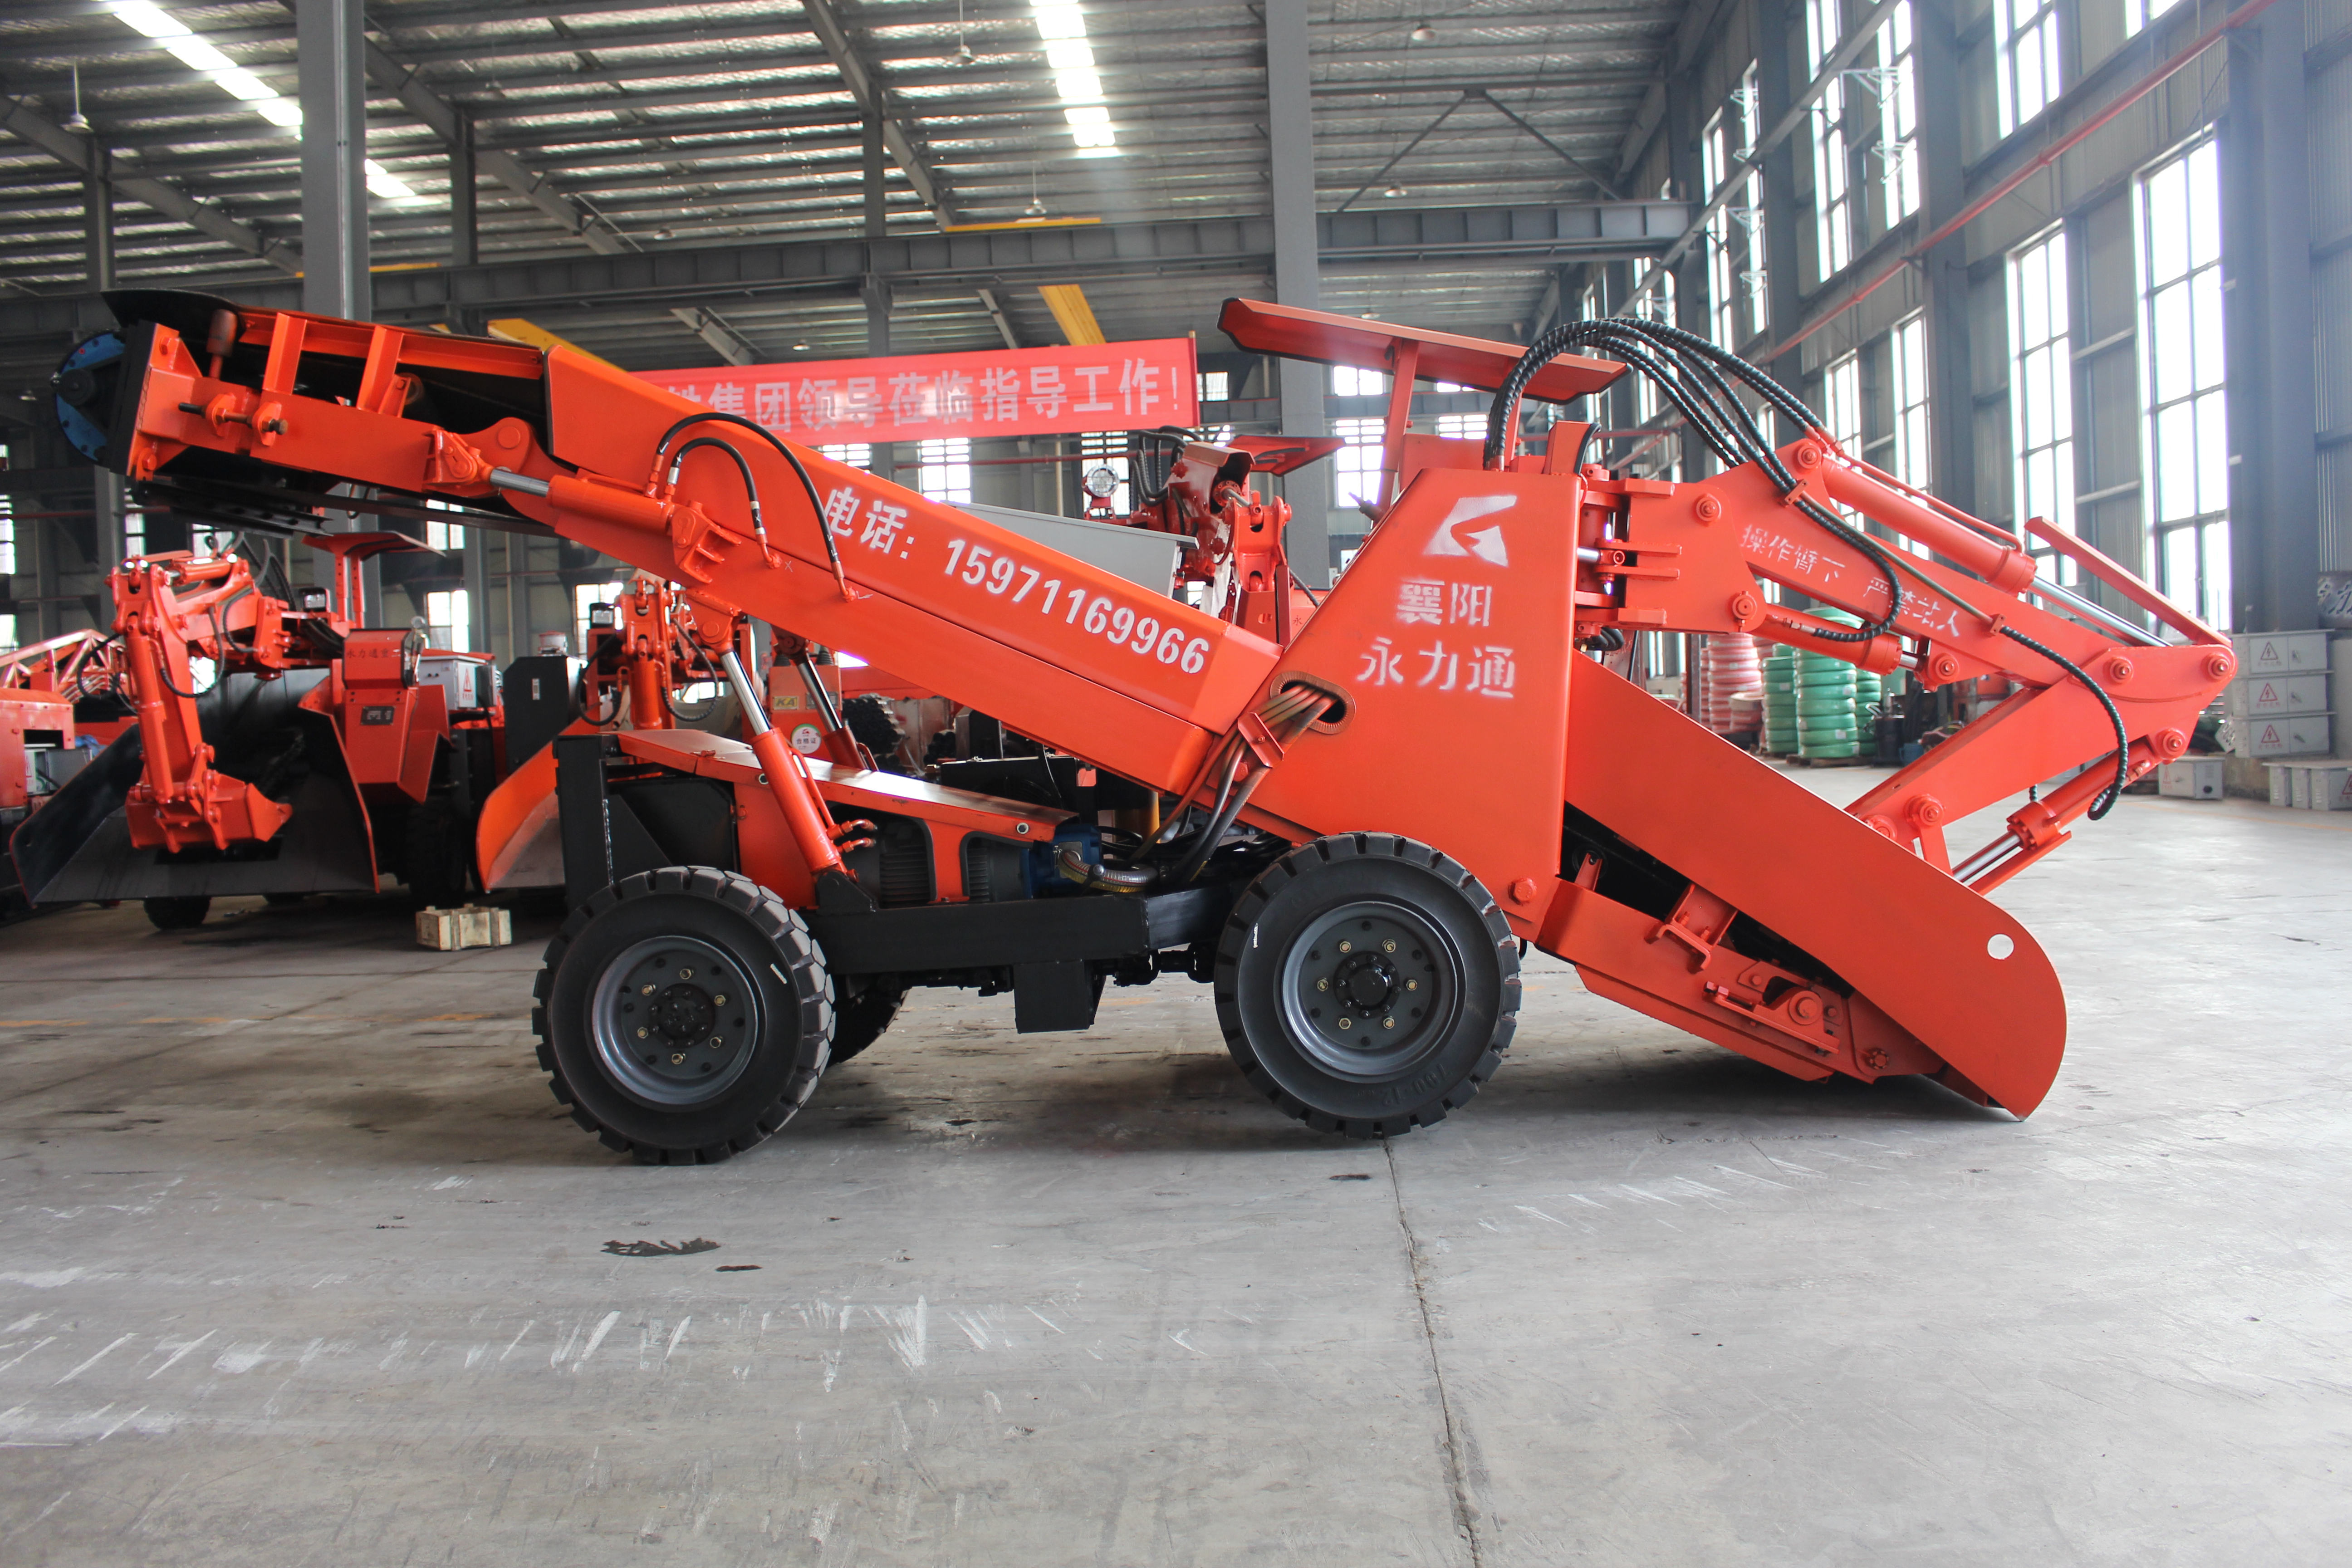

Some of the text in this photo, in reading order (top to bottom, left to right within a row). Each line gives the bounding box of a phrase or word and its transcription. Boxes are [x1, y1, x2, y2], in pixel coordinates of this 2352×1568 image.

[823, 487, 1210, 674] 电话： 15971169966
[1740, 524, 1846, 583] 操作臂下
[1396, 577, 1492, 627] 襄阳
[1356, 636, 1515, 698] 永力通
